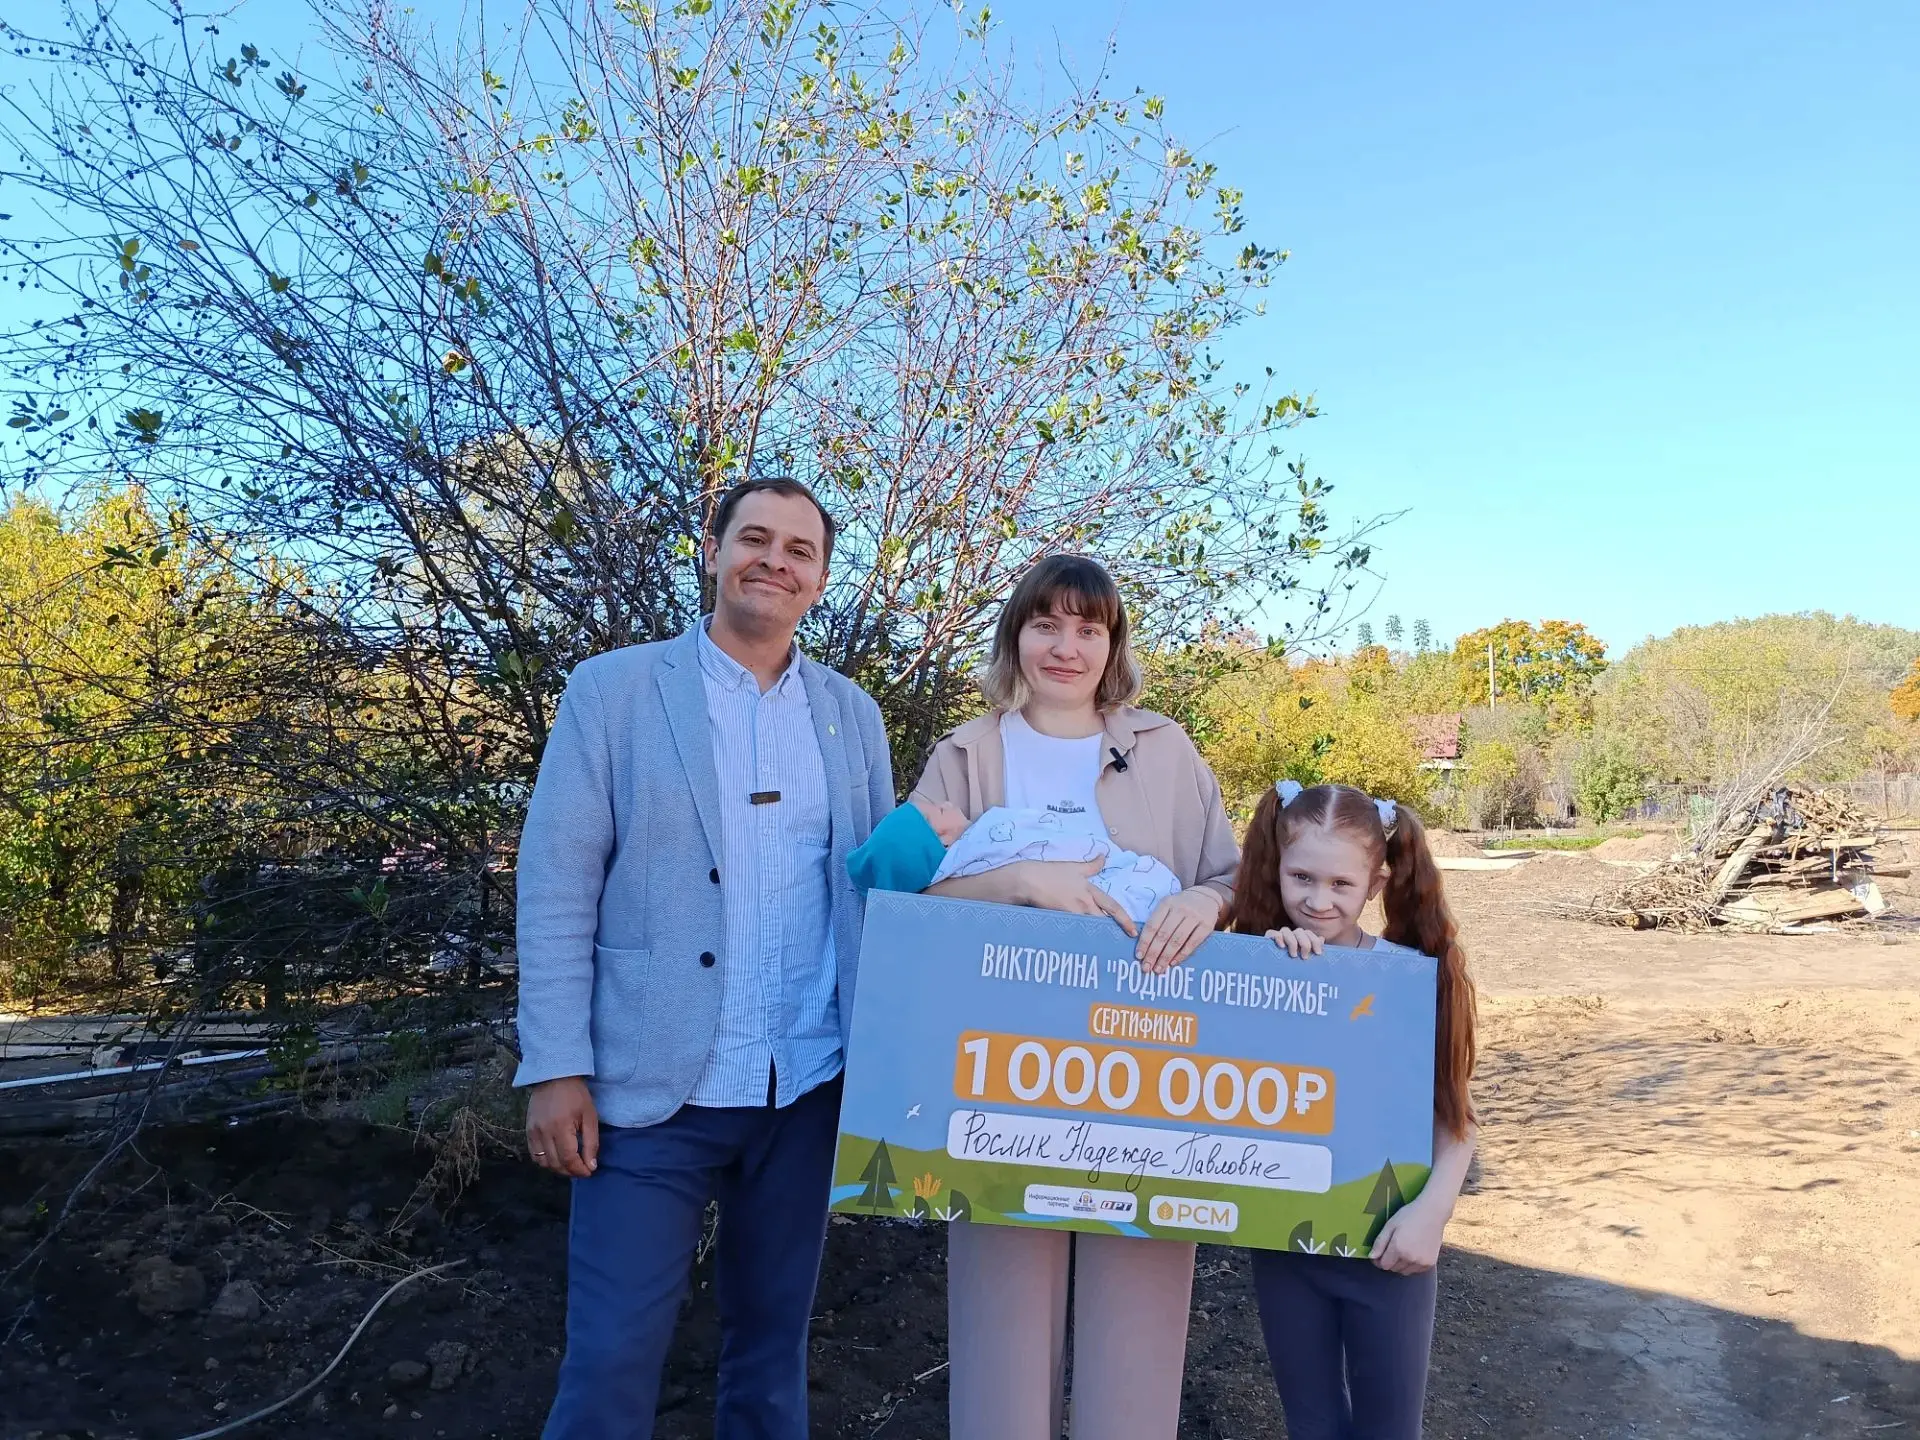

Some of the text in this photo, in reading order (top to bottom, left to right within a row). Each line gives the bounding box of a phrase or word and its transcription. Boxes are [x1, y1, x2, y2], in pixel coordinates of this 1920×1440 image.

[981, 942, 1099, 990] ВИКТОРИНА
[1200, 969, 1339, 1017] ОРЕНБУРЖЬЕ"
[1092, 1007, 1194, 1043] СЕРТИФИКАТ
[963, 1037, 990, 1096] 1
[1007, 1041, 1141, 1112] 000
[963, 1109, 1052, 1159] Рослик
[1058, 1120, 1168, 1191] Надежде
[1176, 1203, 1230, 1227] РСМ
